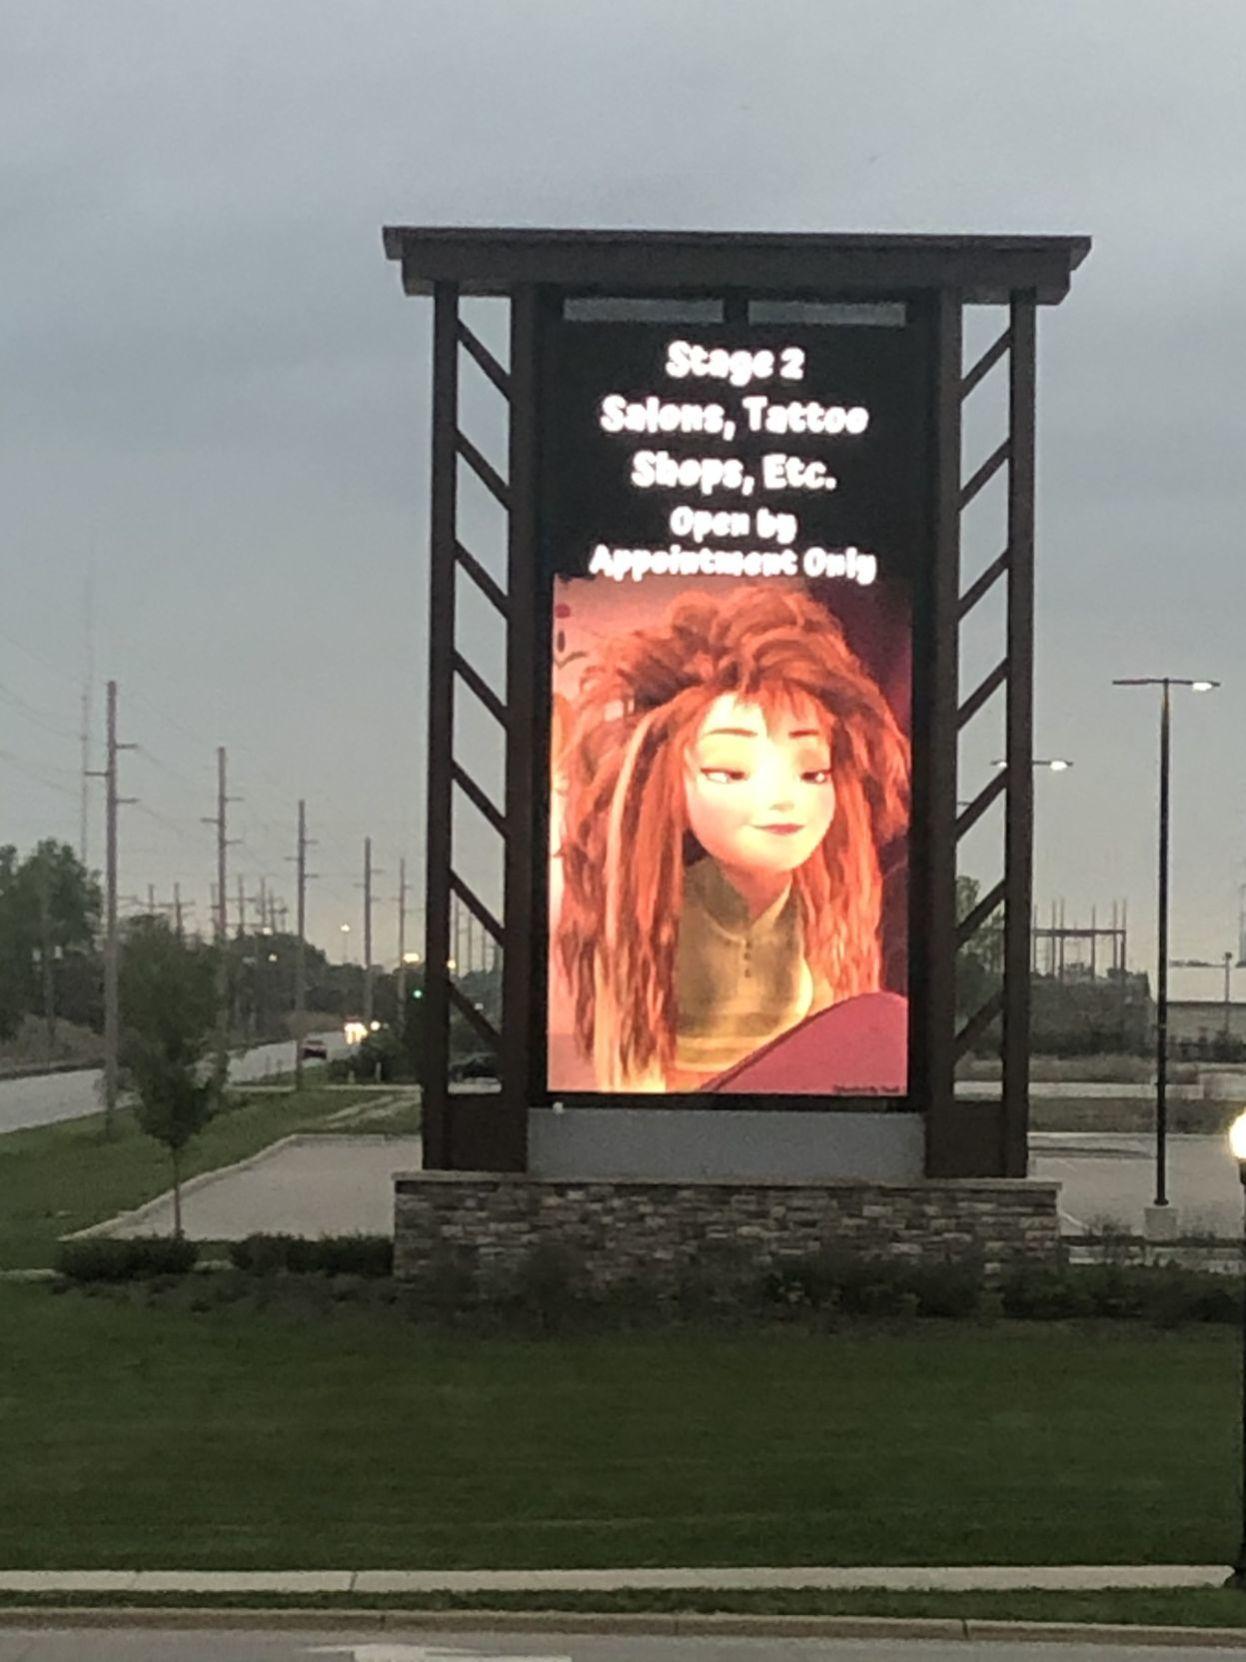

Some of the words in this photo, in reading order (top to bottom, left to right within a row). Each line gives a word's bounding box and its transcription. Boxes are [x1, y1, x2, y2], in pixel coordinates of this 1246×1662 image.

[665, 340, 774, 386] Stage
[780, 347, 805, 380] 2
[600, 395, 736, 440] Salons,
[743, 396, 869, 434] Tattoo
[631, 450, 755, 496] Shops,
[762, 454, 837, 490] Etc.
[670, 506, 750, 542] Open
[756, 507, 797, 544] by
[589, 544, 798, 582] Appointment
[803, 547, 877, 585] Only
